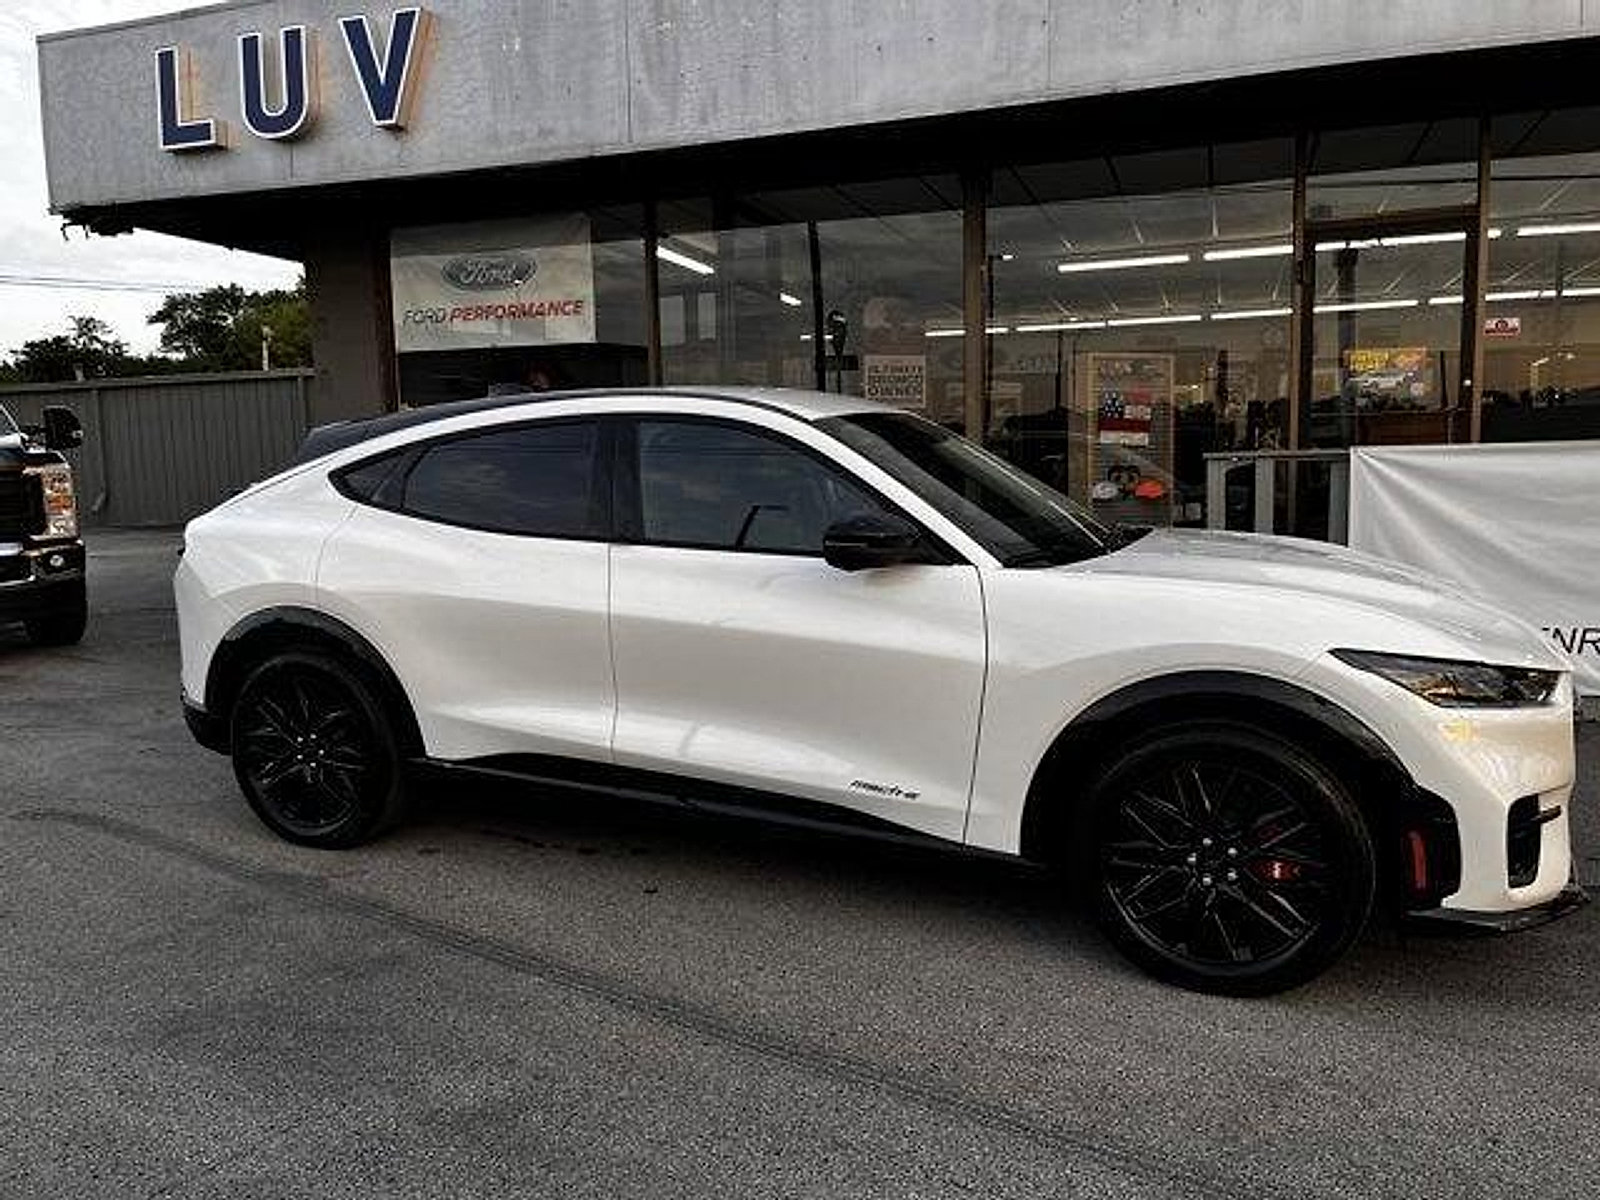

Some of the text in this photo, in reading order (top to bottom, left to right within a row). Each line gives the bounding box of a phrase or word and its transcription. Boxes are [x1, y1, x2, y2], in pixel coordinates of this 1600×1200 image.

[155, 8, 421, 149] LUV
[403, 300, 585, 325] FORD PERFORMANCE
